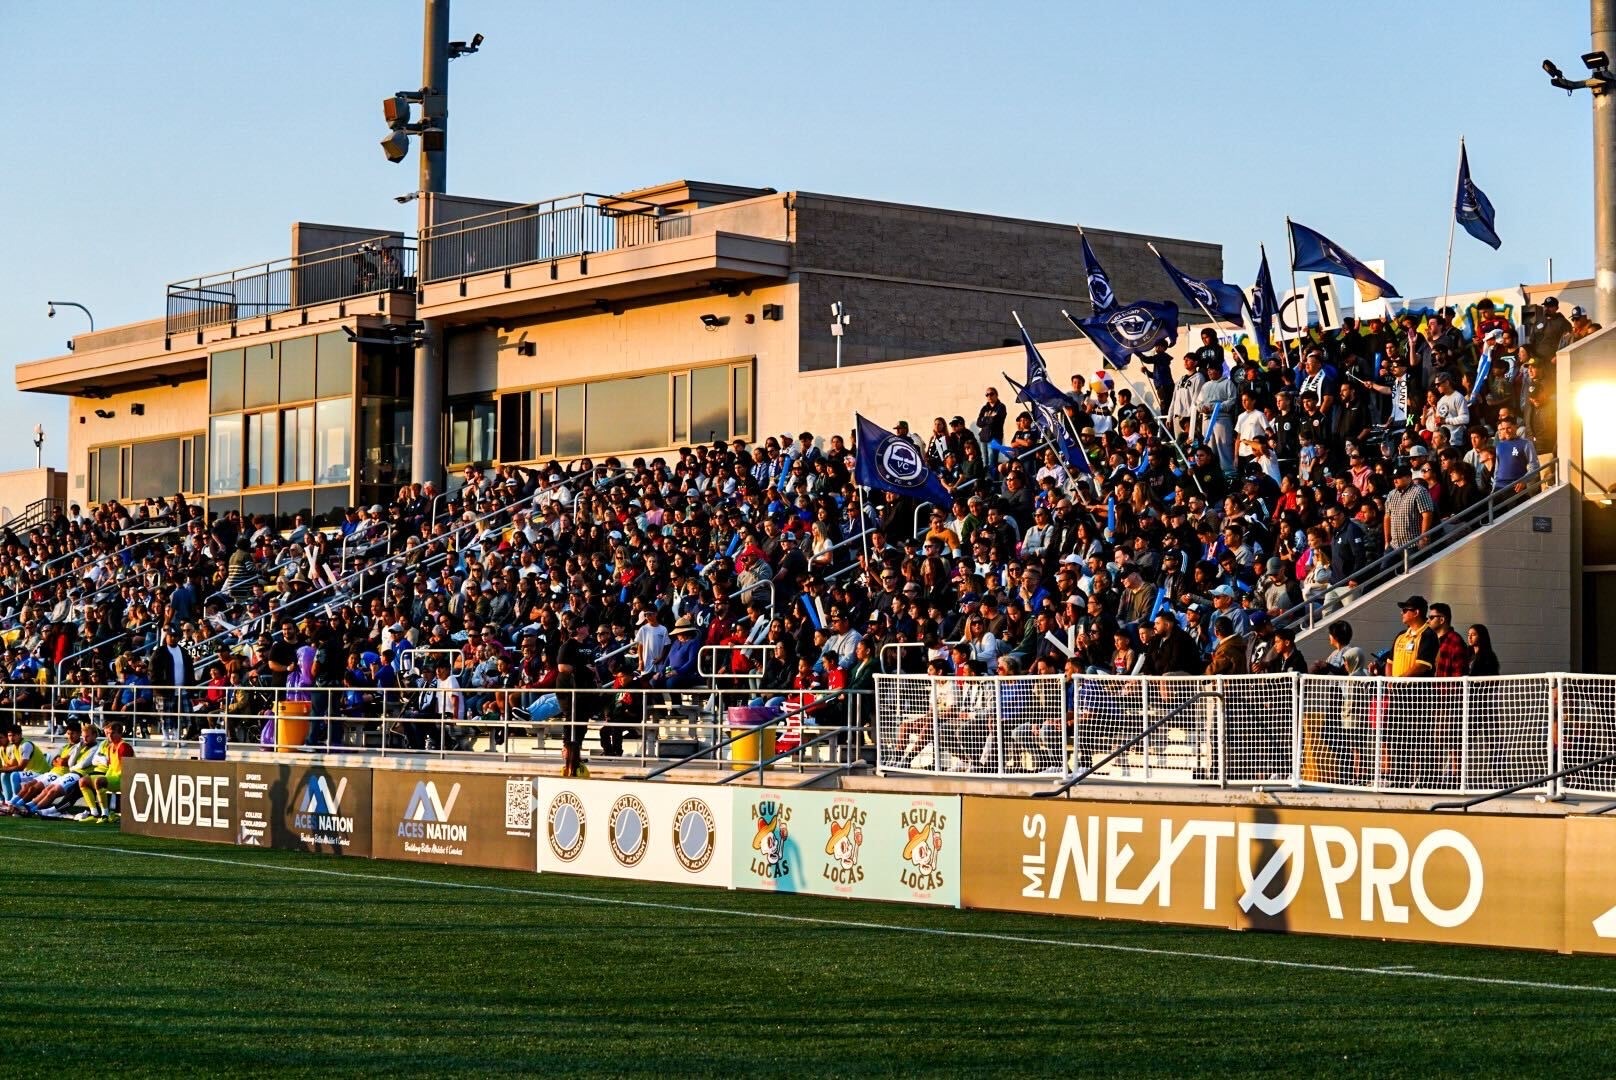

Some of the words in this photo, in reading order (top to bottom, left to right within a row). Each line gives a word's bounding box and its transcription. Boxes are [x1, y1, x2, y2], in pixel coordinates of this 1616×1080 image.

[1314, 276, 1331, 327] F
[1279, 294, 1304, 333] C
[897, 460, 909, 470] VC
[129, 772, 229, 828] OMBEE
[549, 795, 567, 824] MATCH
[751, 801, 793, 821] AGUAS
[295, 813, 317, 830] ACES
[318, 815, 353, 833] NATION
[610, 797, 628, 828] MATCH
[674, 801, 694, 832] MATCH
[824, 804, 867, 826] AGUAS
[901, 808, 947, 830] AGUAS
[398, 822, 425, 838] ACES
[426, 823, 467, 841] NATION
[563, 835, 583, 858] ACADEMY
[625, 839, 646, 863] ACADEMY
[690, 844, 712, 869] ACADEMY
[750, 857, 790, 878] LOCAS
[822, 862, 864, 885] LOCAS
[1022, 813, 1047, 898] MLS
[1048, 814, 1236, 910] NEXT
[1310, 824, 1484, 928] PRO
[900, 868, 944, 891] LOCAS
